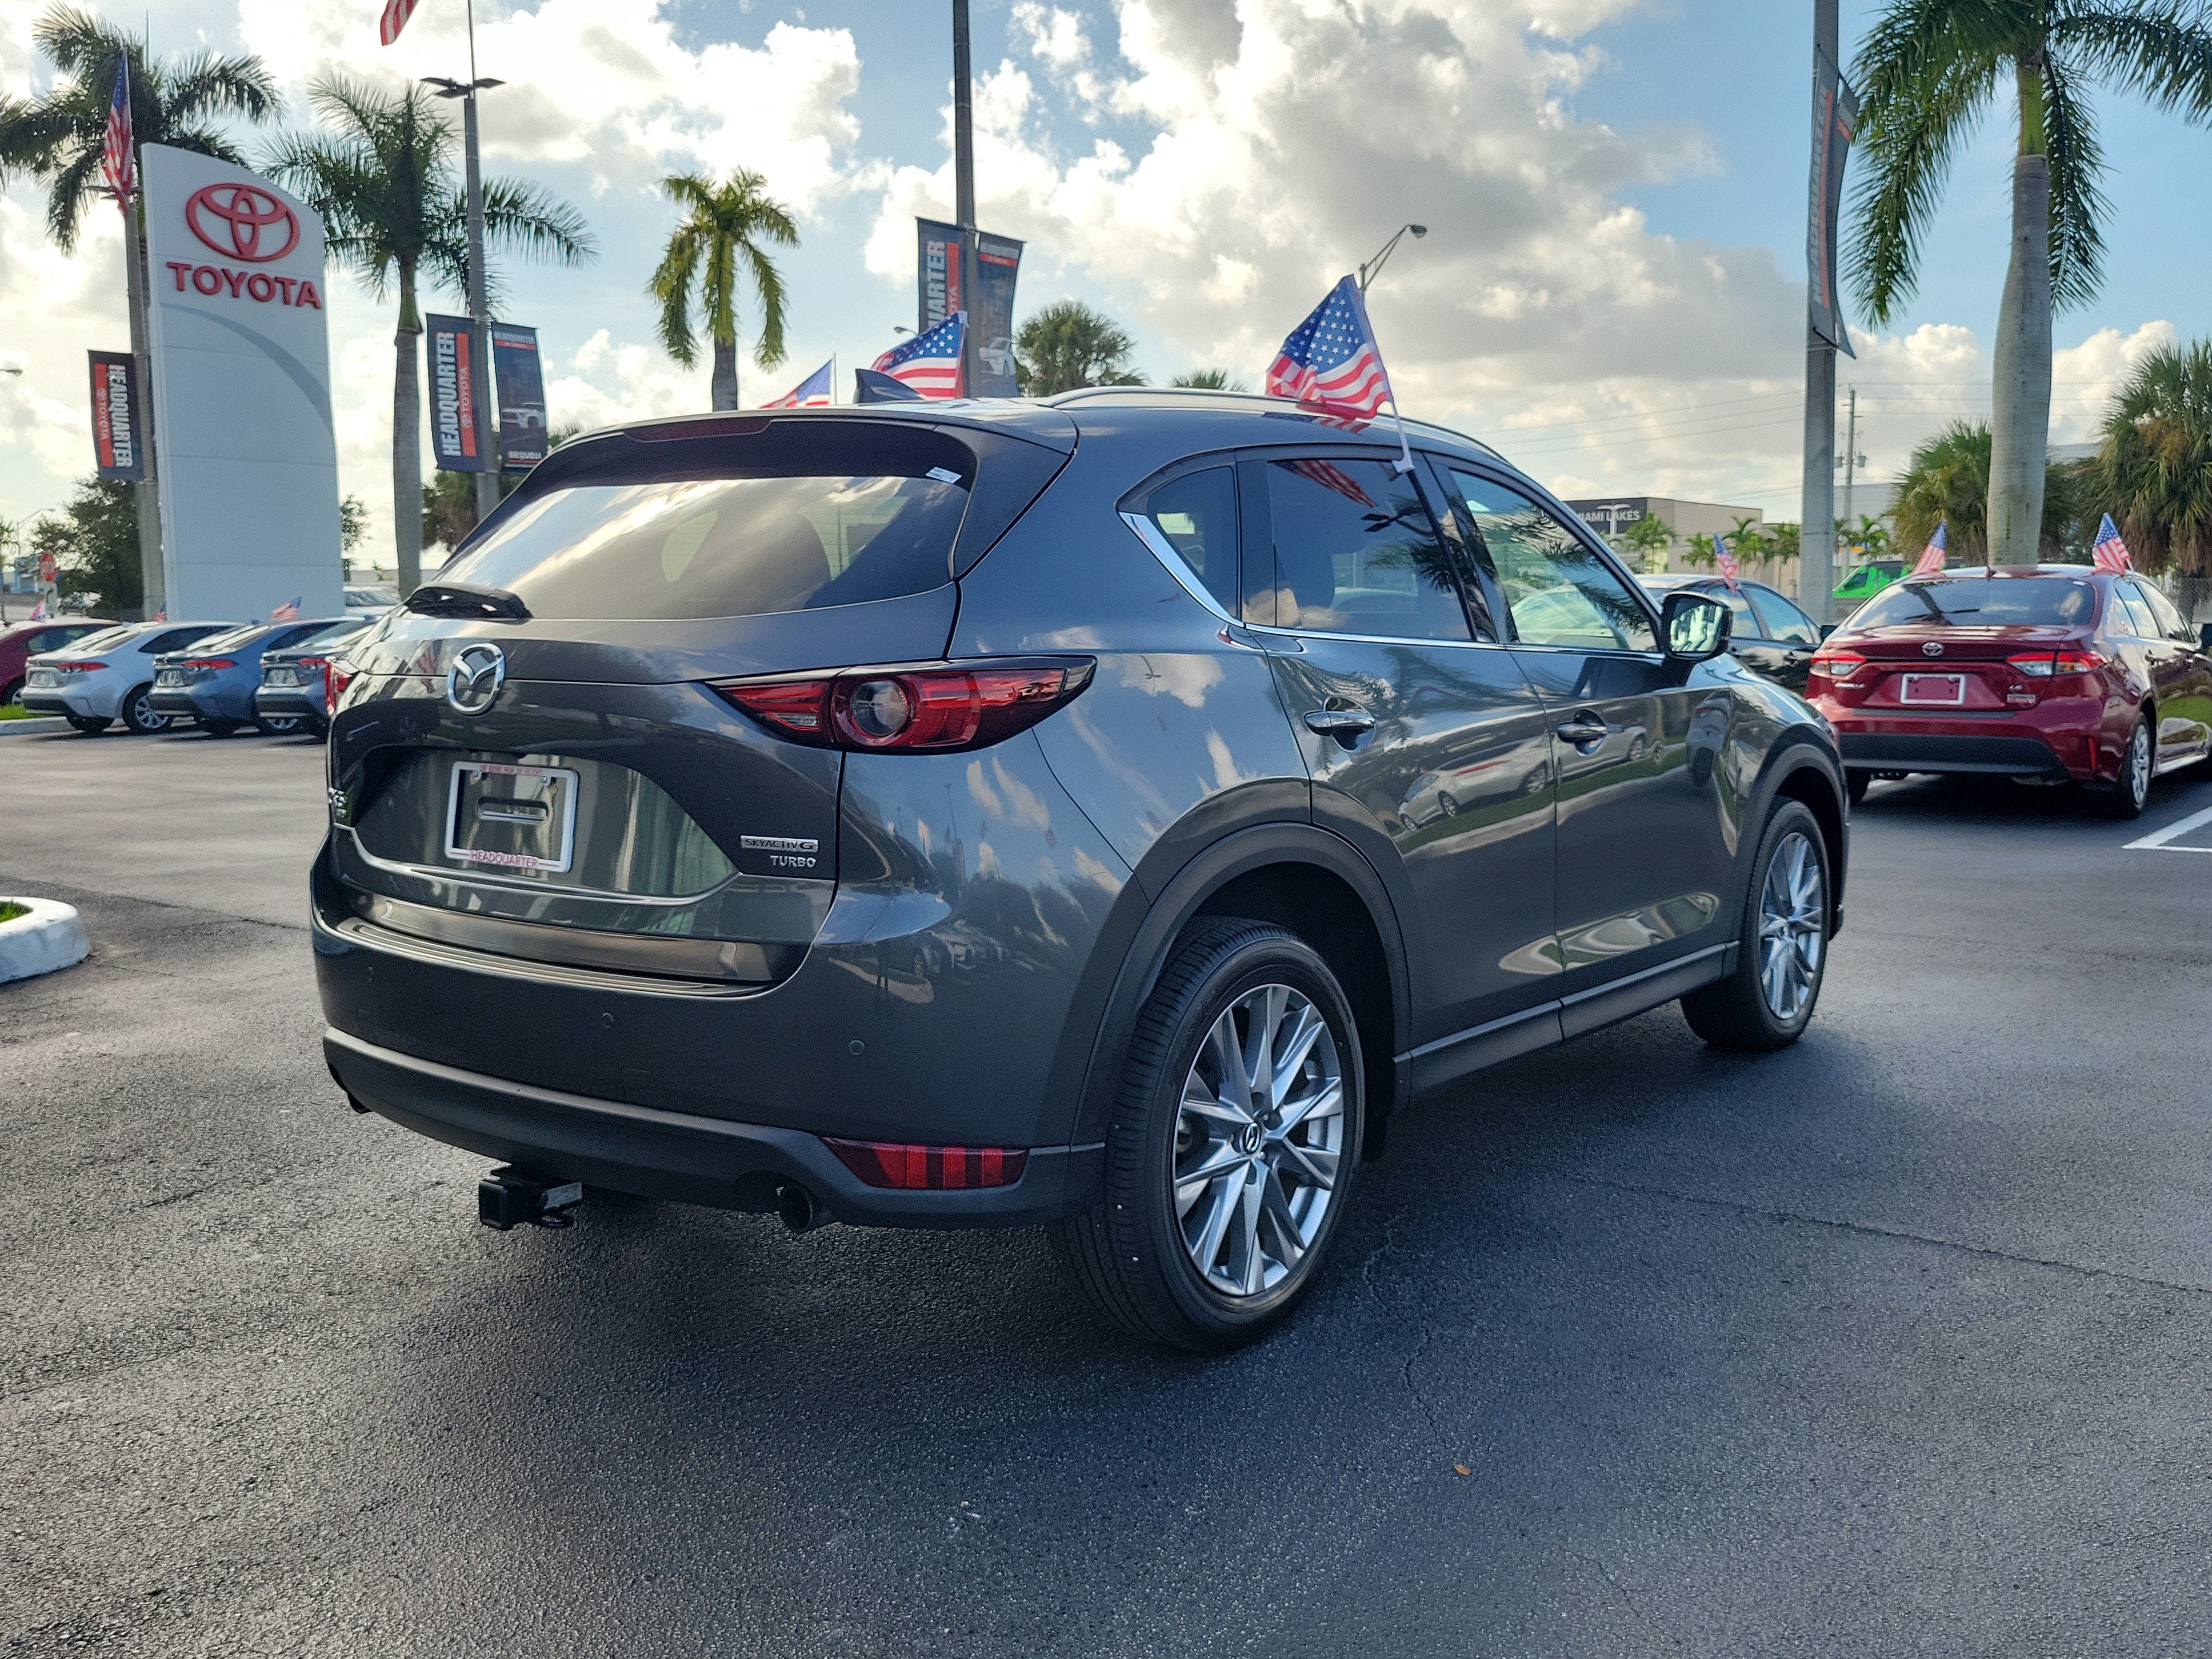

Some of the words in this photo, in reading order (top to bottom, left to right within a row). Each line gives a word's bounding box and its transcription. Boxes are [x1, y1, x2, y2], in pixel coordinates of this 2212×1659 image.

[167, 262, 322, 309] TOYOTA
[927, 241, 946, 327] UARTER
[437, 331, 461, 456] HEADQUARTER
[460, 367, 471, 411] TOYOTA
[98, 402, 110, 440] TOYOTA
[108, 364, 133, 467] HEADQUARTER
[471, 850, 538, 868] HEADQUARTER
[745, 838, 798, 849] SKYACTIV
[770, 855, 816, 868] TURBO
